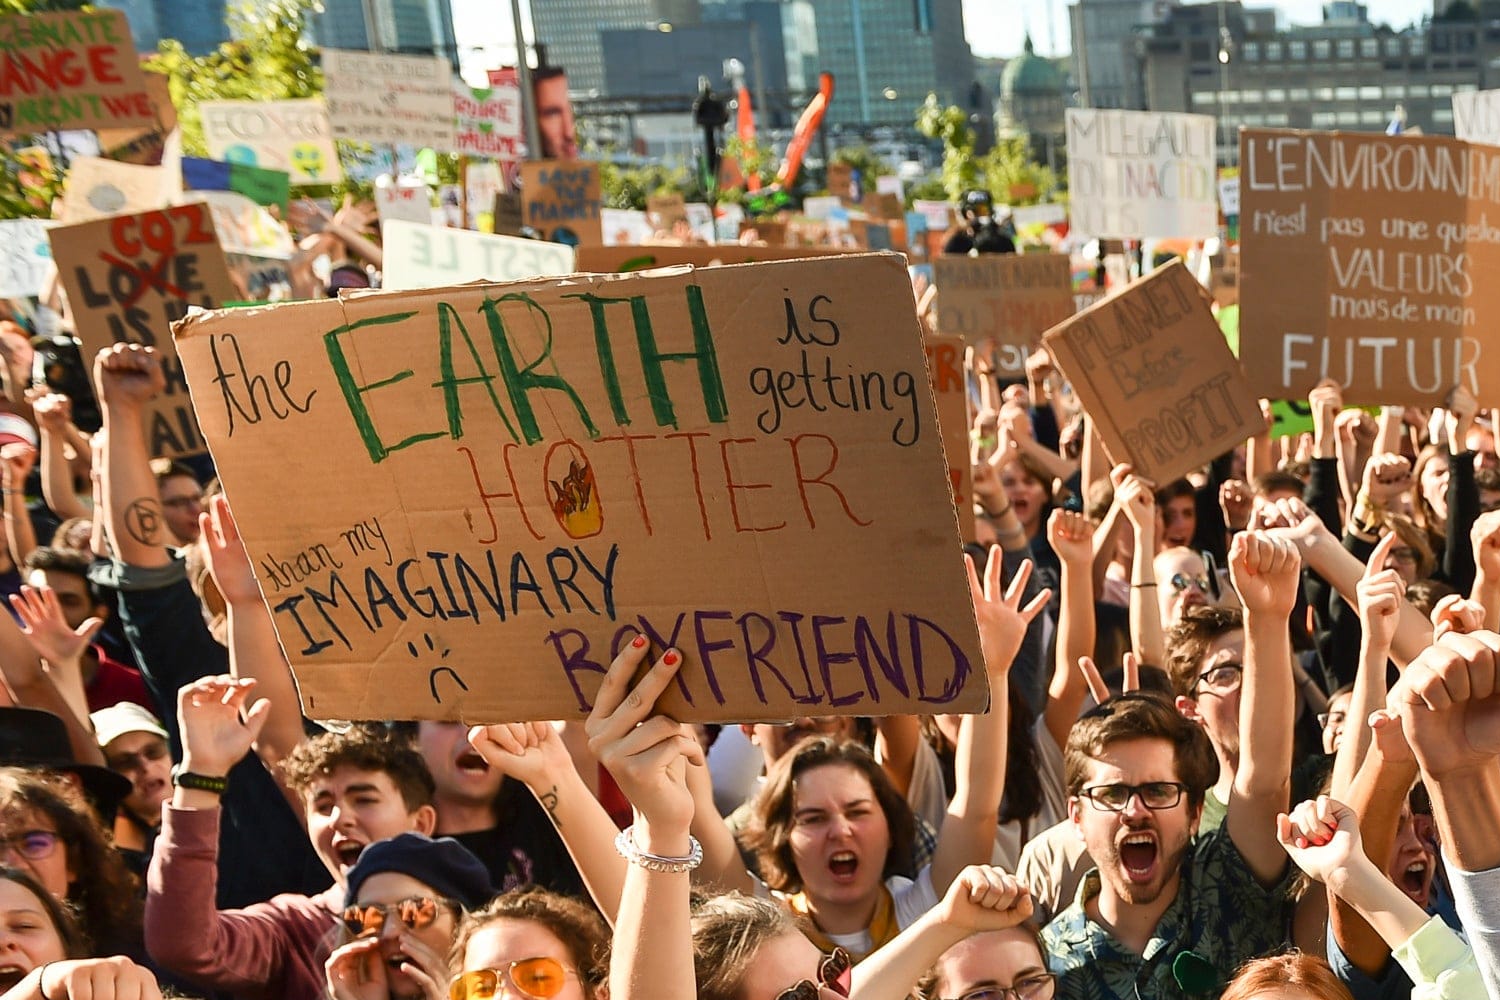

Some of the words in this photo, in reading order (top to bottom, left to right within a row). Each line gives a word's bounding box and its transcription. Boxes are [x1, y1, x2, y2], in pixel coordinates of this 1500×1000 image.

[1321, 215, 1365, 244] pas
[1381, 218, 1429, 241] une
[1330, 246, 1473, 298] VALEURS
[1391, 301, 1419, 324] de
[212, 332, 318, 437] the
[323, 284, 729, 464] EARTH
[775, 294, 841, 348] is
[748, 352, 919, 447] getting
[1282, 333, 1481, 398] FUTUR
[150, 405, 201, 457] AI
[458, 432, 874, 544] HOTTER
[263, 540, 346, 594] than
[339, 516, 393, 566] my
[273, 543, 620, 656] IMAGINARY
[546, 610, 973, 713] BOYFRIEND
